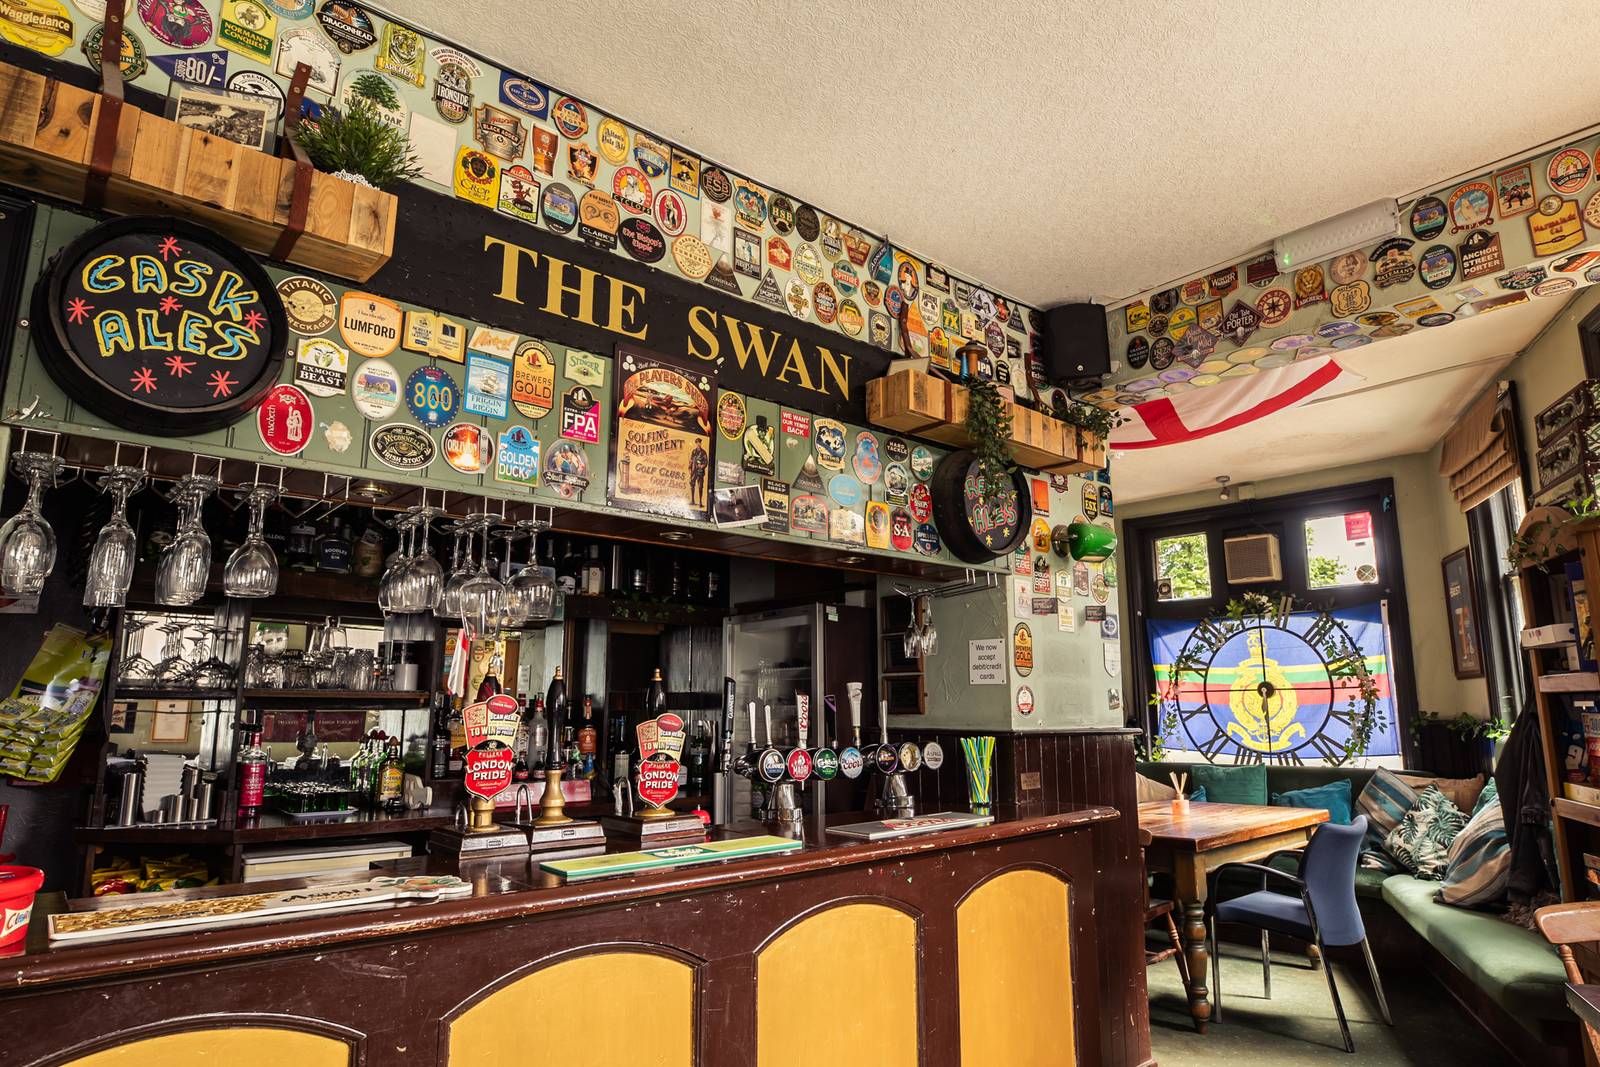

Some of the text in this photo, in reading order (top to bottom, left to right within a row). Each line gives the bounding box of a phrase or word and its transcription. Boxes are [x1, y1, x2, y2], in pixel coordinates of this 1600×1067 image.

[0, 3, 70, 32] Waggledance
[224, 21, 270, 46] NORMAN'S
[322, 15, 373, 41] DRAGONHEAD
[224, 28, 268, 51] CONQUEST
[185, 57, 222, 85] 80/-
[241, 73, 276, 90] PREMIUM
[438, 85, 469, 107] IRONSIDE
[442, 99, 464, 113] BEST
[482, 123, 519, 142] BLACK ADDER
[705, 178, 729, 195] ESB
[613, 193, 652, 215] CYCLOPS
[582, 227, 615, 241] CLARK'S
[1462, 246, 1498, 261] ANCHOR
[1463, 252, 1499, 269] STREET
[1464, 260, 1500, 275] PORTER
[710, 275, 737, 289] CONSPIRACY
[835, 270, 860, 285] SPITFIRE
[82, 255, 259, 321] CASK
[282, 280, 332, 302] TITANIC
[484, 235, 853, 402] THE SWAN
[1226, 315, 1254, 330] PORTER
[1229, 312, 1239, 320] Old
[93, 308, 260, 360] ALES
[343, 317, 396, 340] LUMFORD
[302, 365, 341, 378] EXMOOR
[569, 356, 601, 375] STINGER
[977, 361, 992, 376] IPA
[299, 371, 343, 387] BEAST
[515, 371, 552, 387] BREWERS
[639, 369, 683, 390] PLAYERS
[414, 382, 453, 412] 800
[514, 380, 552, 399] GOLD
[471, 394, 502, 407] FRIGGIN
[472, 404, 500, 415] RIGGIN
[266, 404, 276, 437] macbeth
[564, 411, 597, 434] FPA
[782, 412, 810, 424] WE WANT
[627, 430, 669, 445] GOLFING
[786, 426, 804, 436] BACK
[625, 439, 685, 457] EQUIPMENT
[886, 445, 908, 455] TACKLE
[382, 449, 424, 464] IRISH STOUT
[500, 450, 538, 467] GOLDEN
[635, 463, 686, 481] GOLF CLUBS
[767, 485, 787, 493] SHEEP
[972, 501, 1018, 535] ALES
[264, 533, 286, 541] ULLDOG
[977, 654, 996, 663] accept
[1015, 651, 1032, 661] GOLD
[971, 663, 1002, 671] debit/credit
[490, 713, 503, 721] SCAN
[799, 695, 809, 730] Coors
[470, 725, 496, 737] TO WIN
[643, 742, 665, 750] TO WIN
[466, 760, 515, 774] LONDON
[473, 770, 506, 781] PRIDE
[640, 771, 679, 782] LONDON
[645, 781, 673, 789] PRIDE
